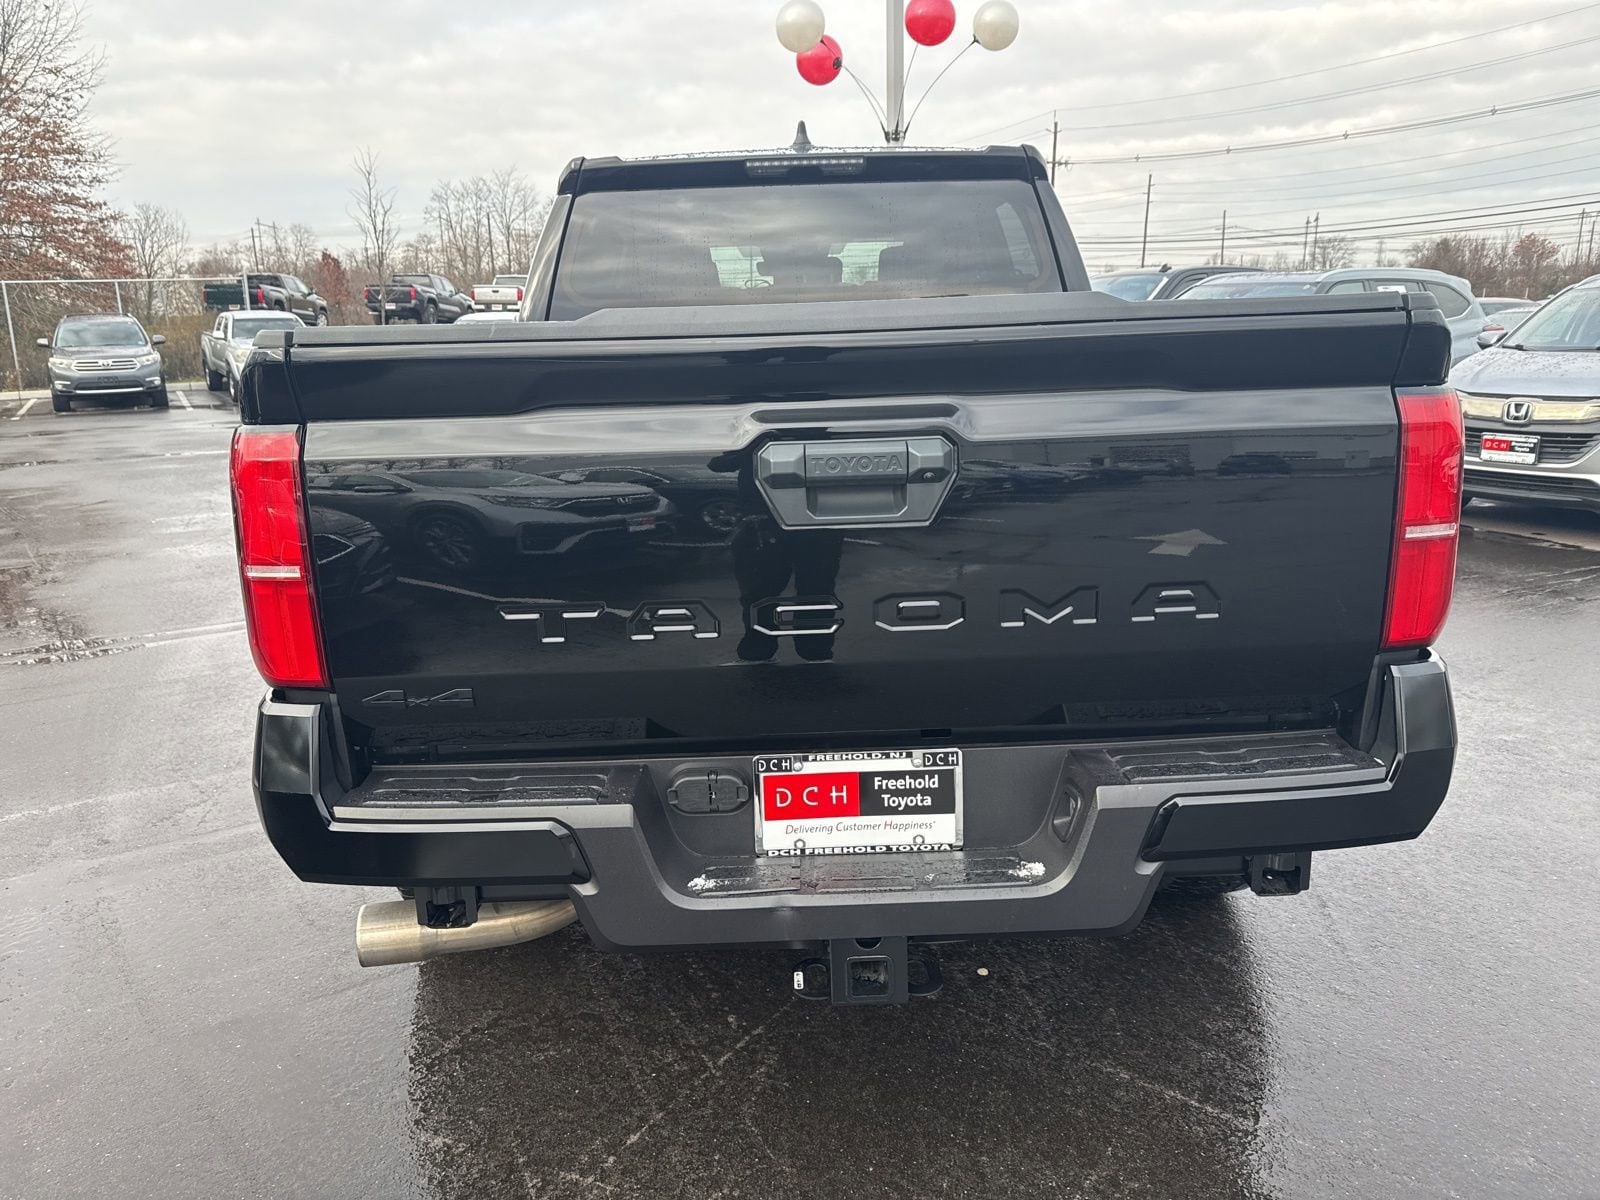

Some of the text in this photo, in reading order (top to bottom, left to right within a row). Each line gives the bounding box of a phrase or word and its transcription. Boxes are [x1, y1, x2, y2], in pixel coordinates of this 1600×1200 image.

[811, 455, 903, 473] TOYOTA
[496, 580, 1221, 644] TACOMA
[874, 774, 939, 790] Freehold
[775, 785, 848, 808] DCH
[881, 794, 932, 811] Toyota
[785, 824, 833, 835] Delivering
[835, 821, 882, 832] Customer
[768, 843, 951, 857] DCH FREEHOLD TOYOTA
